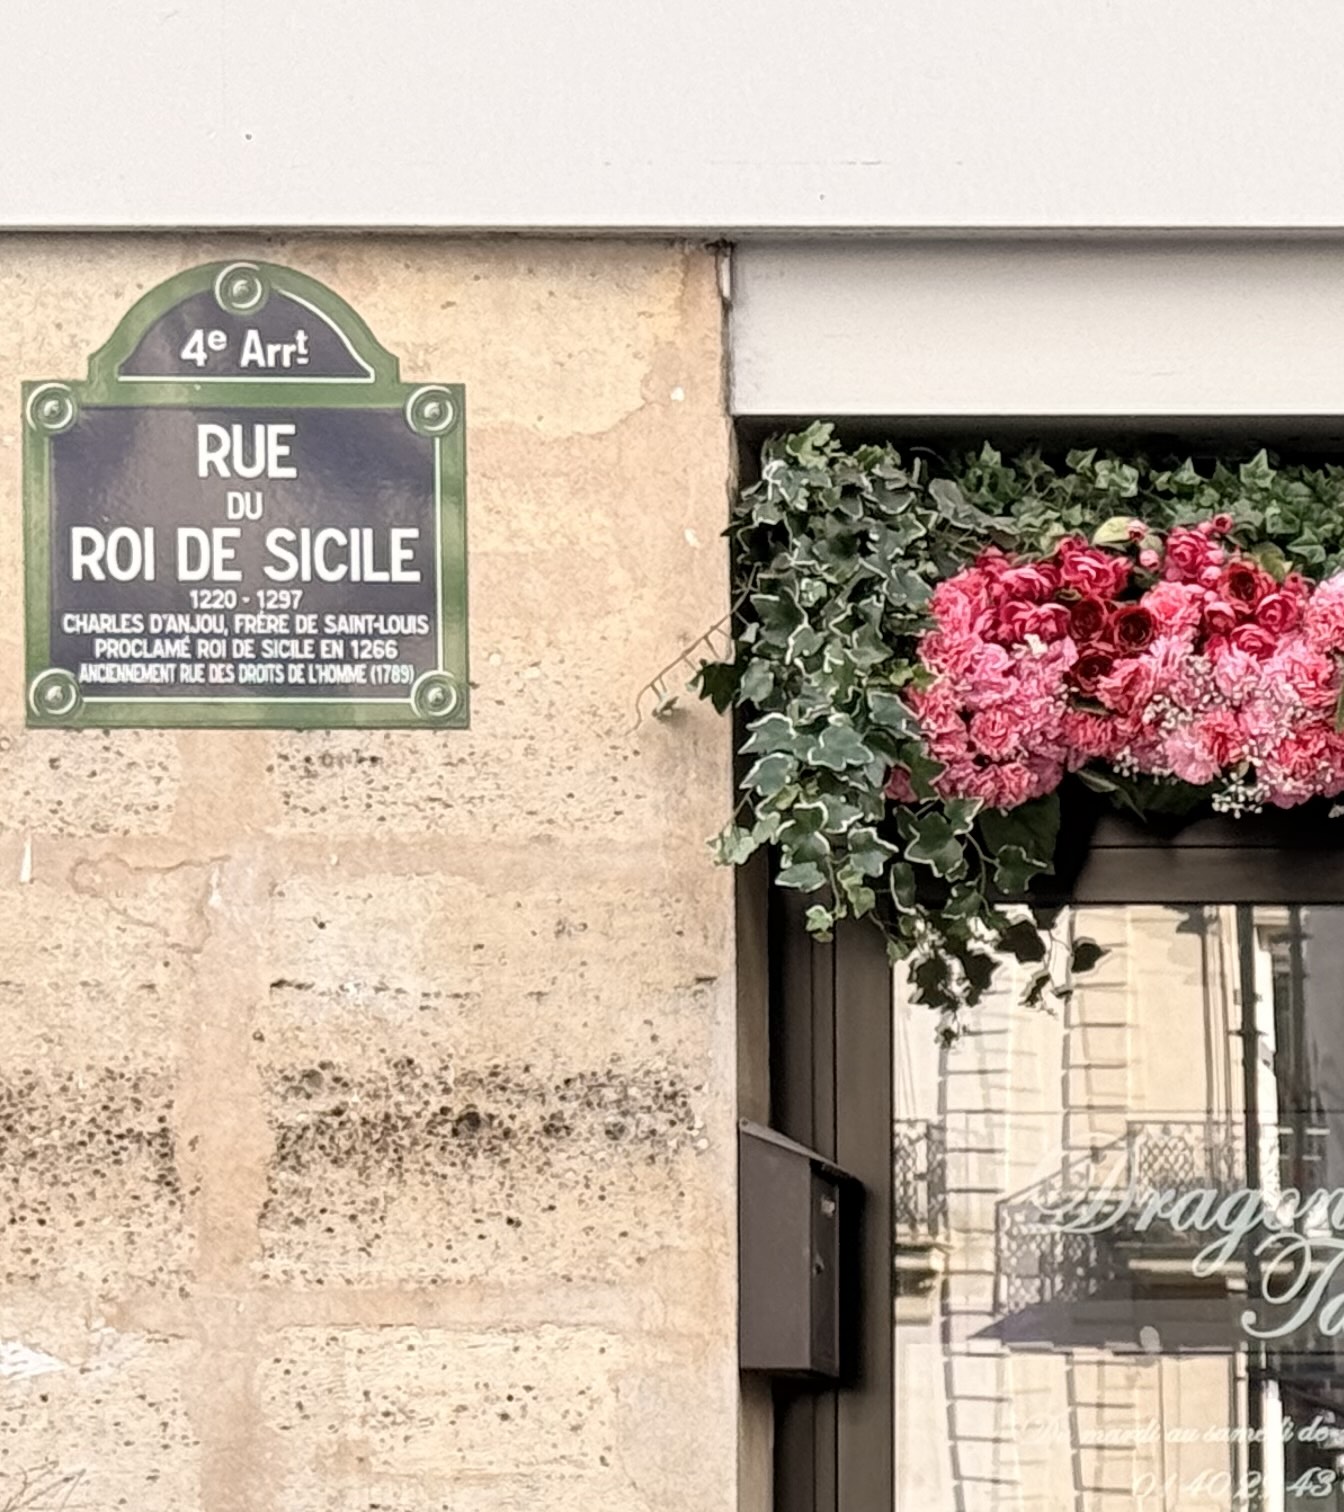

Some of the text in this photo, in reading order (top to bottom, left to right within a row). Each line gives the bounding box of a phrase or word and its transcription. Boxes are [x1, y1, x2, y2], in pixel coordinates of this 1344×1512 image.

[180, 328, 309, 368] 4e Arrt
[197, 423, 297, 478] RUE
[227, 491, 263, 520] DU
[71, 526, 421, 583] ROI DE SICILE
[189, 588, 237, 610] 1220
[256, 588, 303, 610] 1297
[62, 613, 145, 634] CHARLES
[149, 613, 229, 637] D'ANJOU,
[295, 613, 319, 634] DE
[323, 613, 430, 635] SAINT-LOUIS
[94, 635, 398, 660] PROCLAMÉ ROI DE SICILE EN 1266
[78, 663, 415, 685] ANCIENNEMENT RUE DES DROITS DE L'HOMME (1789)
[1203, 1415, 1294, 1444] samei
[1287, 1466, 1337, 1498] 43
